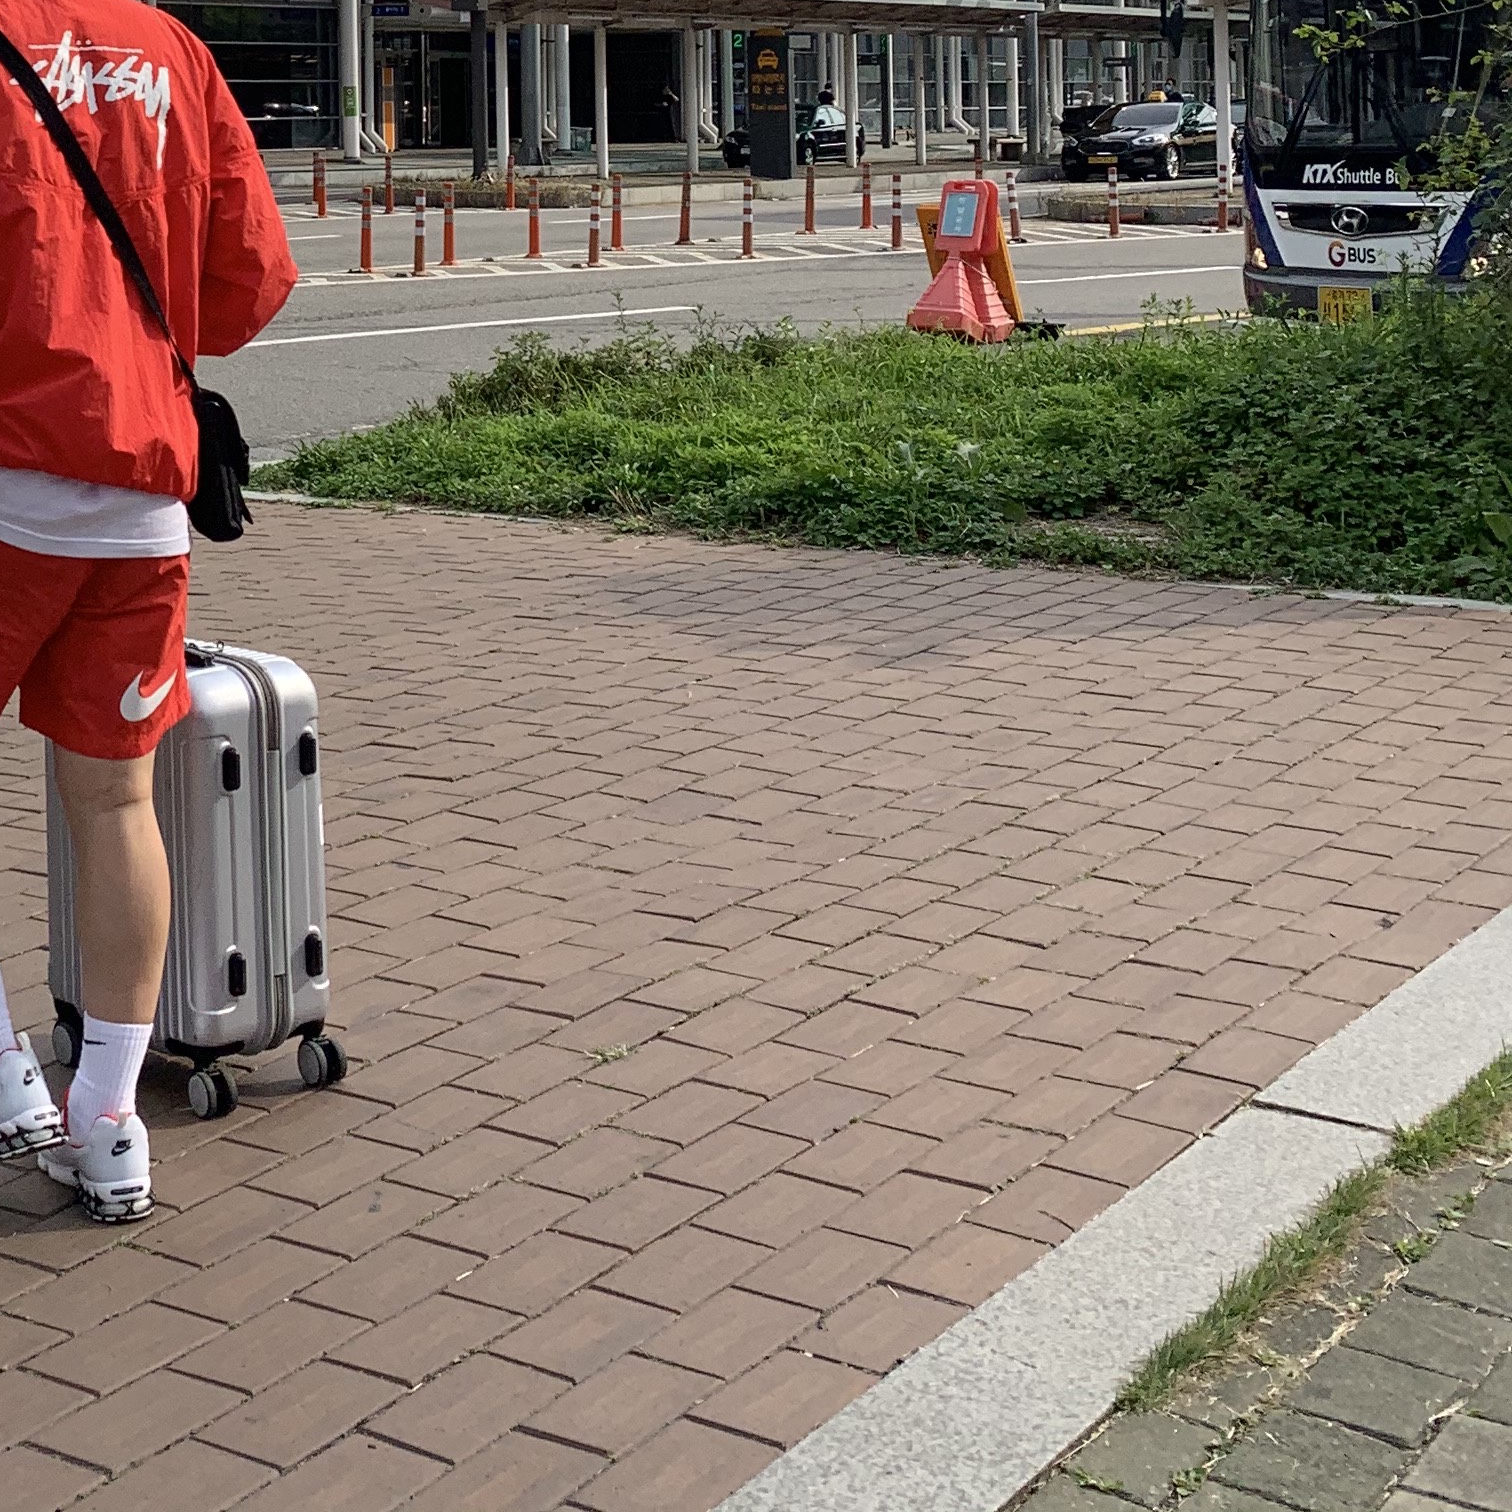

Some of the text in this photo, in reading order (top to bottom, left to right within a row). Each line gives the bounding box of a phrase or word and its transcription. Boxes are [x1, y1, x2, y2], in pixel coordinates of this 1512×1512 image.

[733, 34, 743, 47] 2
[1302, 159, 1402, 184] KTX Shuttle Bu
[1328, 240, 1376, 267] G BUS
